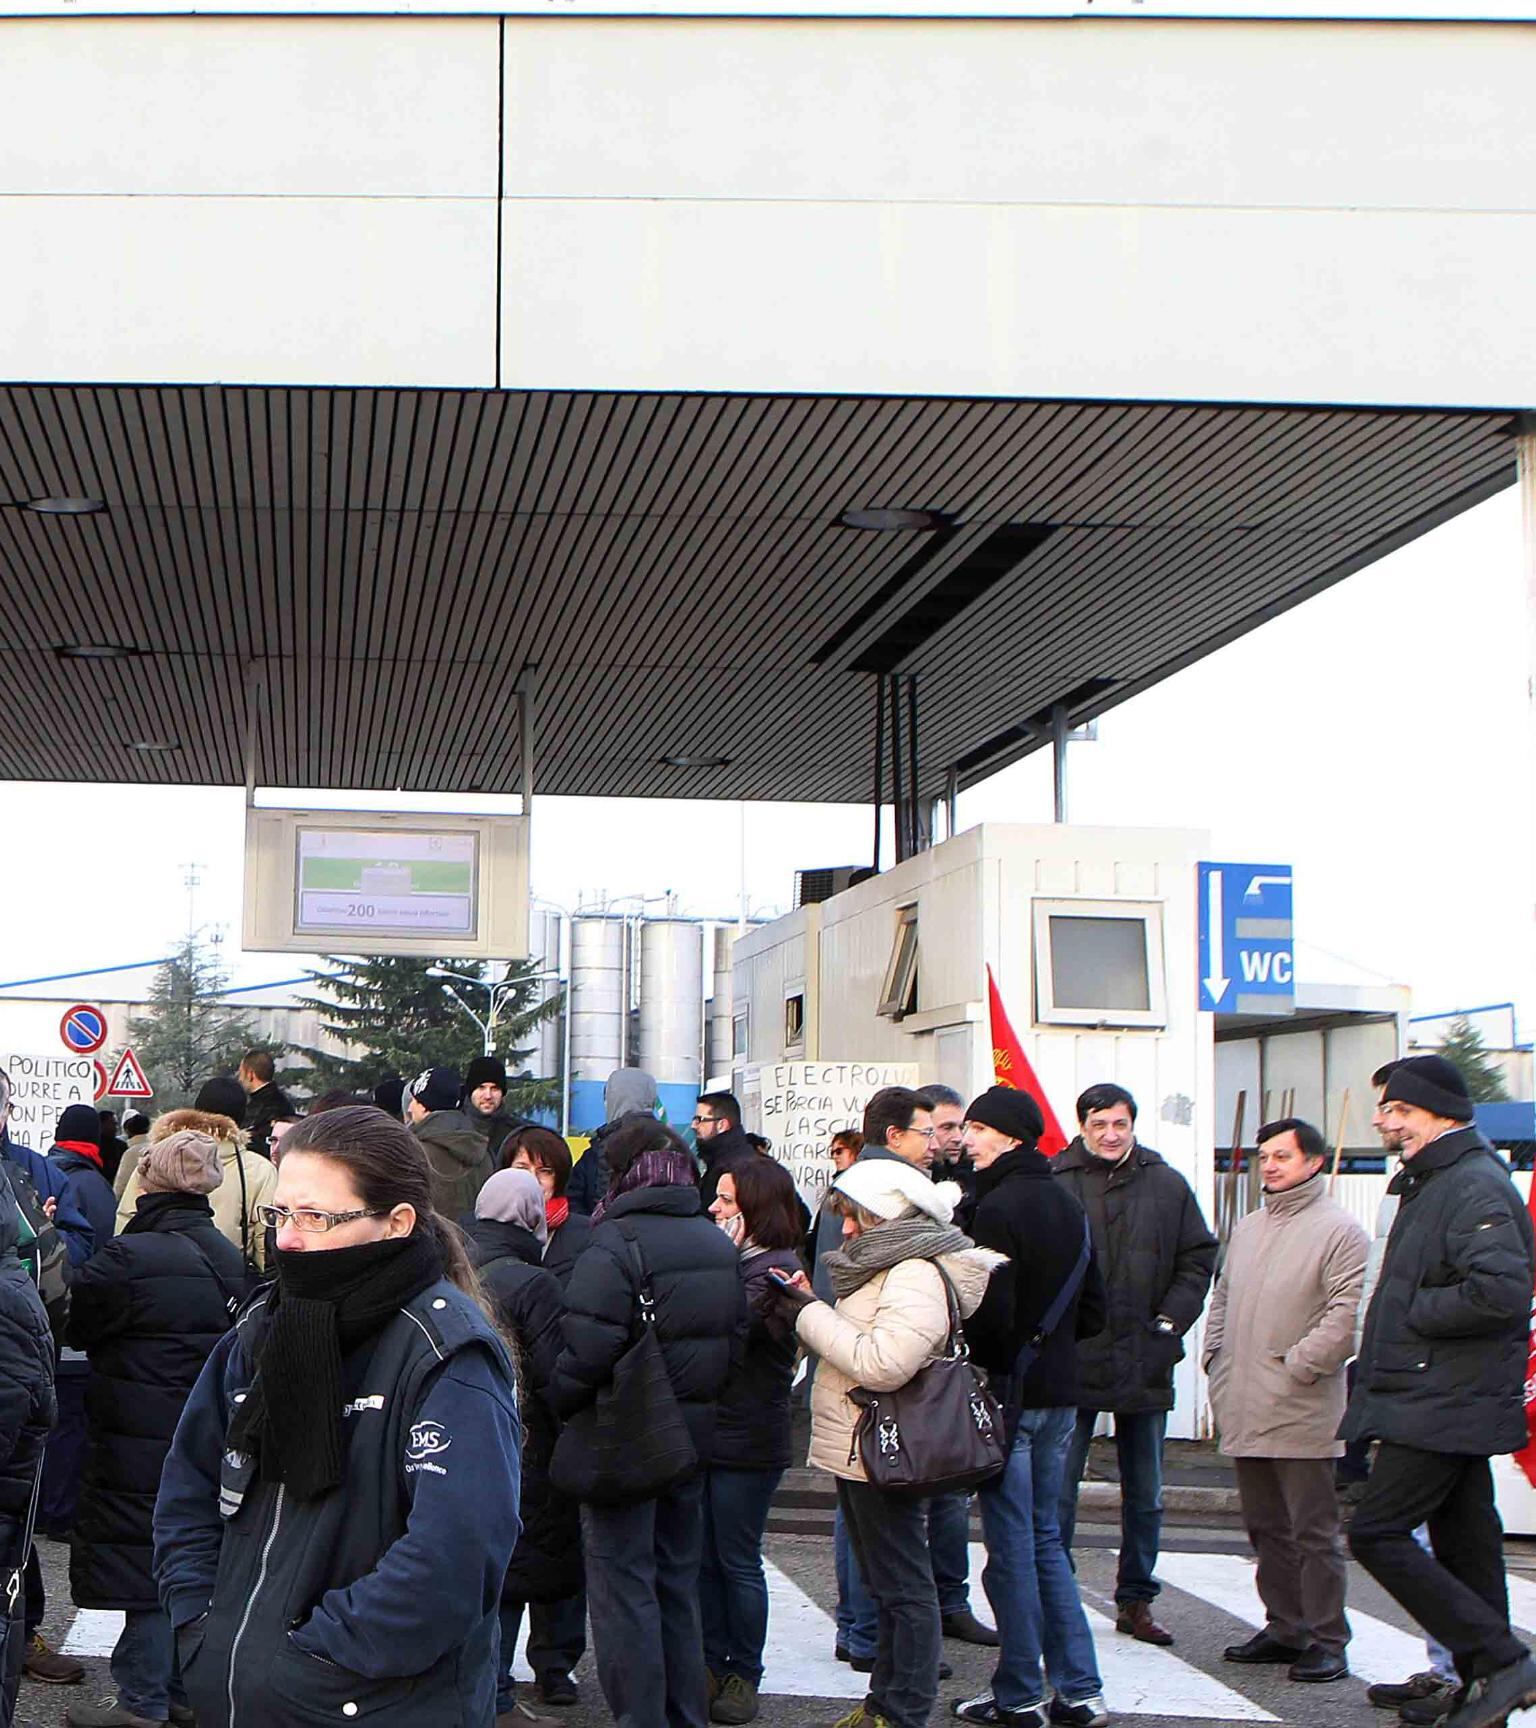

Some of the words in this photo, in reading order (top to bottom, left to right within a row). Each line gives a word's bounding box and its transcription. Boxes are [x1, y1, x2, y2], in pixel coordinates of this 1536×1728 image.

[347, 903, 375, 918] 200
[1239, 950, 1293, 984] WC
[9, 1055, 91, 1078] POLITICO
[69, 1085, 81, 1101] A
[843, 1096, 868, 1113] VU
[411, 1431, 440, 1448] EMS
